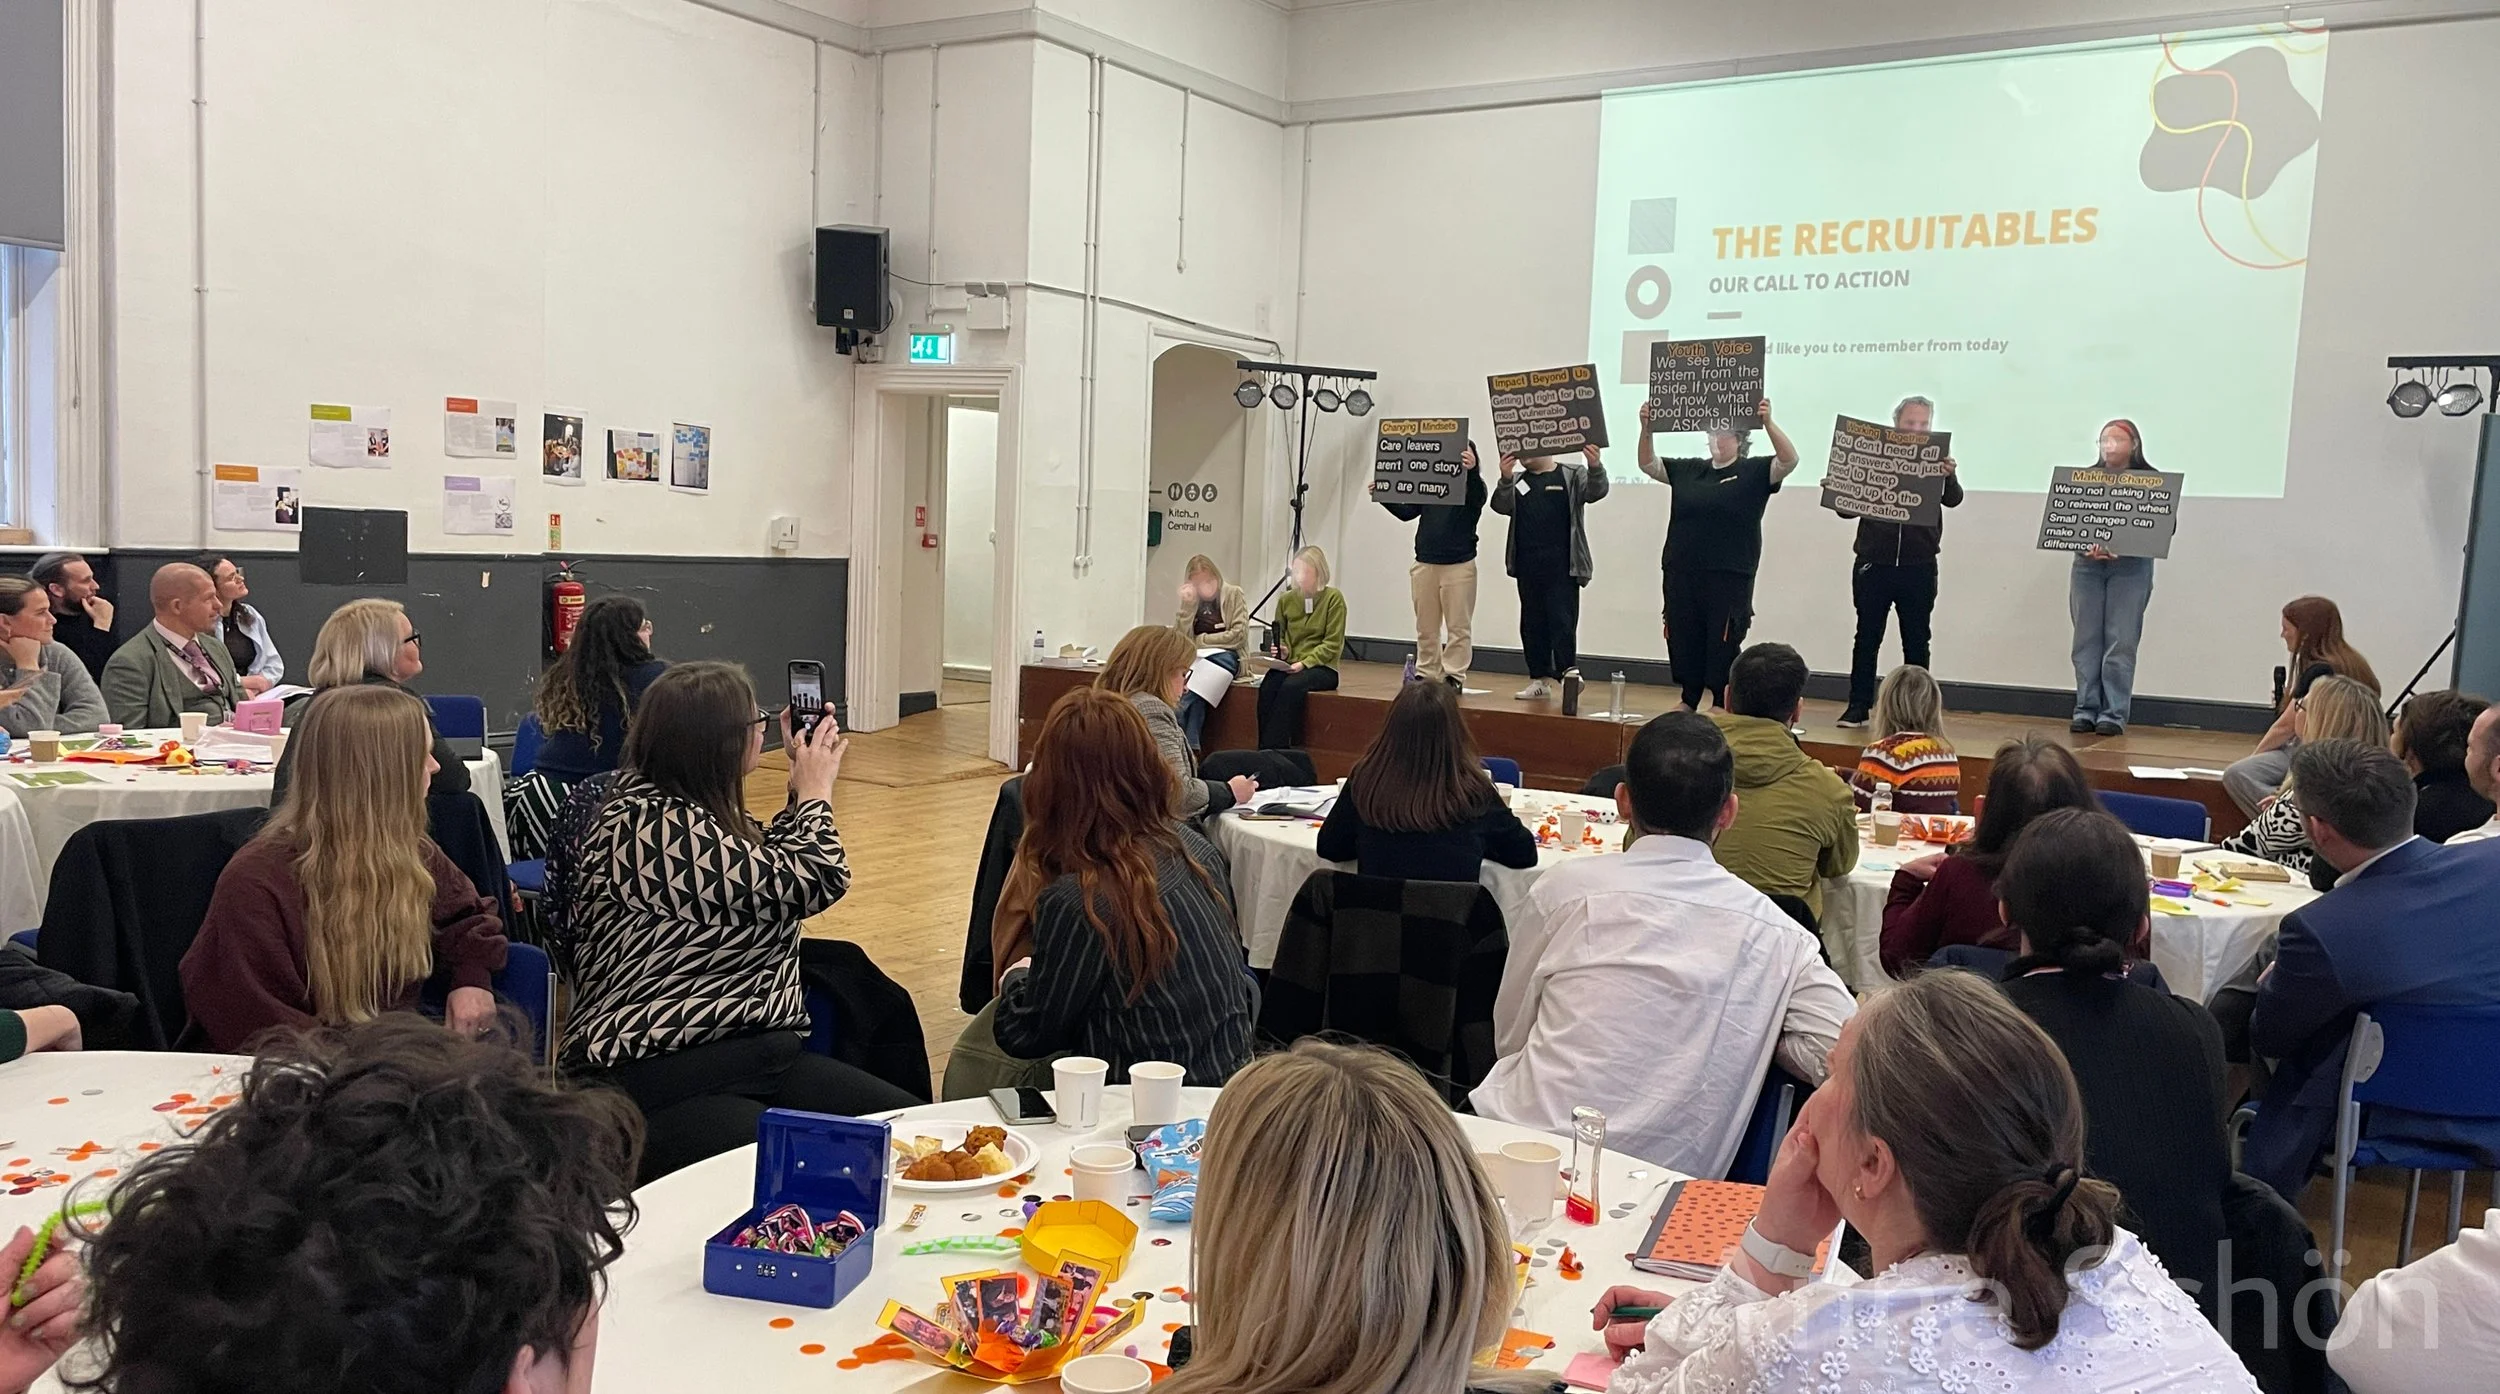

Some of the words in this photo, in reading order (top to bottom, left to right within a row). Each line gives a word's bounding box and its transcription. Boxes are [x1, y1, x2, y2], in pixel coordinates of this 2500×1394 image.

[1712, 224, 1782, 260] THE
[1793, 207, 2099, 257] RECRUITABLES
[1709, 276, 1749, 293] OUR
[1753, 274, 1799, 292] CALL
[1804, 273, 1830, 290] TO
[1834, 269, 1910, 289] ACTION
[1667, 342, 1706, 357] Youth
[1713, 340, 1753, 356] Voice
[1776, 342, 1801, 354] like
[1804, 343, 1829, 357] you
[1833, 342, 1847, 353] to
[1850, 339, 1924, 353] remember
[1927, 339, 1962, 352] from
[1966, 338, 2009, 354] today
[1656, 356, 1677, 369] We
[1686, 356, 1711, 367] see
[1716, 355, 1737, 367] the
[1494, 376, 1525, 389] Impact
[1532, 370, 1567, 385] Beyond
[1574, 369, 1588, 379] Us
[1650, 370, 1696, 384] system
[1701, 366, 1731, 380] from
[1738, 365, 1760, 377] the
[1692, 381, 1701, 394] If
[1703, 383, 1727, 396] you
[1730, 378, 1763, 391] want
[1492, 396, 1522, 406] Getting
[1536, 392, 1556, 403] right
[1560, 389, 1574, 399] for
[1577, 387, 1593, 397] the
[1649, 396, 1662, 407] to
[1672, 394, 1707, 406] know
[1717, 392, 1750, 404] what
[1495, 410, 1516, 420] most
[1520, 406, 1565, 418] vulnerable
[1649, 407, 1681, 421] good
[1685, 405, 1720, 417] looks
[1382, 422, 1417, 434] Changing
[1421, 422, 1457, 431] Mindsets
[1497, 424, 1527, 436] groups
[1532, 421, 1555, 433] helps
[1560, 420, 1576, 431] get
[1671, 419, 1701, 431] ASK
[1710, 418, 1734, 431] US!
[1846, 421, 1880, 440] Working
[1885, 429, 1930, 444] Together
[1380, 439, 1402, 451] Care
[1406, 439, 1441, 451] leavers
[1499, 440, 1519, 452] right
[1524, 438, 1537, 448] for
[1836, 432, 1853, 446] You
[1856, 439, 1881, 452] don't
[1885, 445, 1916, 458] need
[1922, 447, 1938, 459] all
[1376, 459, 1402, 470] aren't
[1409, 460, 1428, 470] one
[1831, 449, 1845, 462] the
[1895, 461, 1918, 473] You
[1921, 464, 1943, 476] just
[1829, 464, 1850, 476] need
[1853, 468, 1864, 479] to
[1869, 471, 1896, 486] keep
[2072, 471, 2116, 485] Making
[2118, 474, 2164, 488] Change
[1376, 481, 1390, 490] we
[1397, 482, 1413, 492] are
[1419, 482, 1449, 496] many.
[1827, 477, 1861, 496] howing
[1865, 487, 1879, 499] up
[1884, 489, 1895, 501] to
[1900, 491, 1919, 504] the
[2054, 484, 2082, 495] We're
[2086, 486, 2104, 497] not
[2111, 487, 2144, 499] asking
[2150, 490, 2170, 501] you
[2053, 499, 2064, 509] to
[2069, 500, 2110, 511] reinvent
[2115, 502, 2132, 512] the
[1168, 521, 1196, 531] Central
[2049, 513, 2077, 524] Small
[2083, 514, 2127, 526] changes
[2133, 519, 2153, 528] can
[2046, 527, 2074, 537] make
[2095, 529, 2112, 540] big
